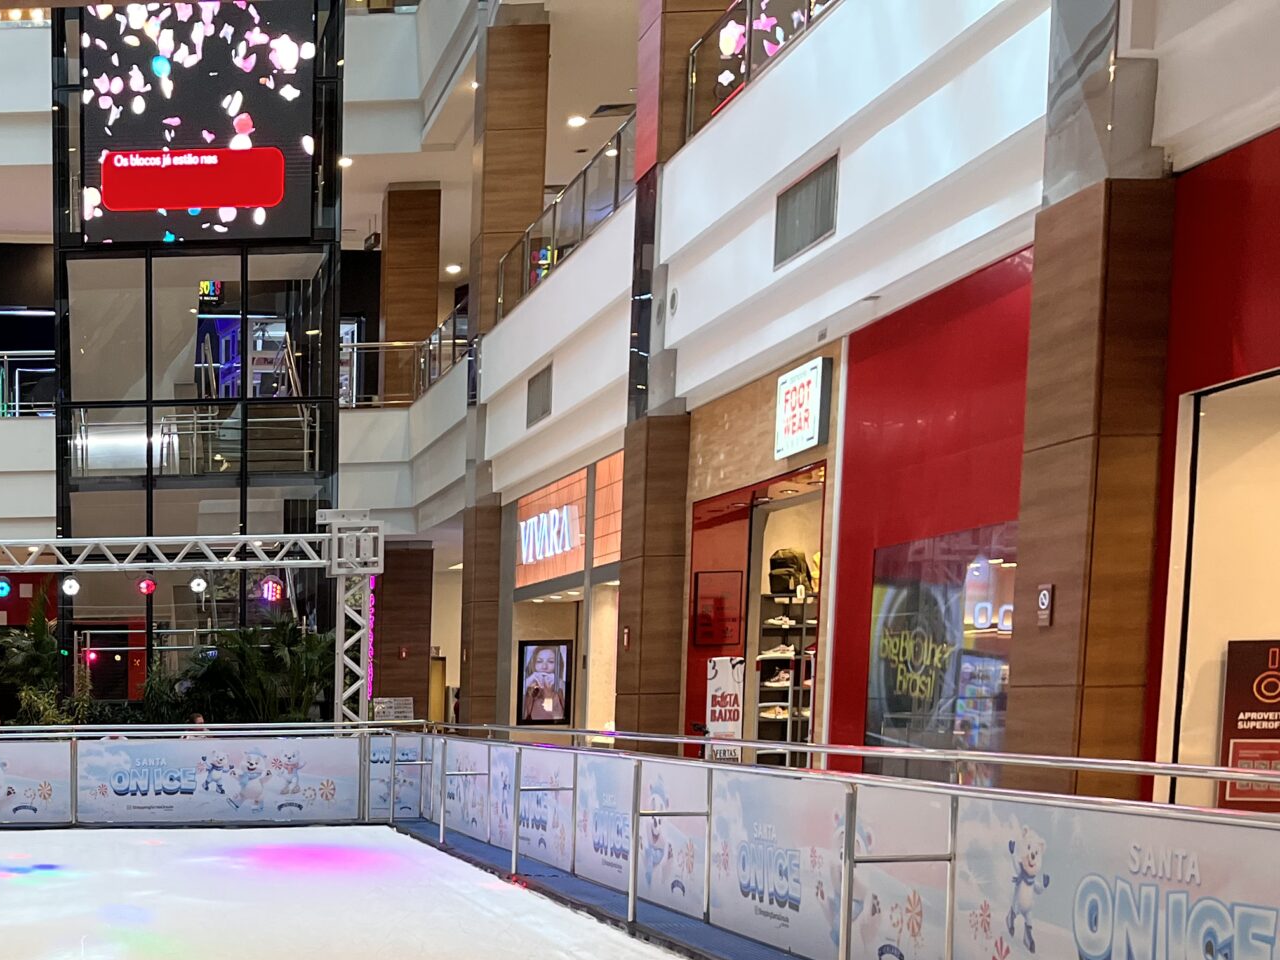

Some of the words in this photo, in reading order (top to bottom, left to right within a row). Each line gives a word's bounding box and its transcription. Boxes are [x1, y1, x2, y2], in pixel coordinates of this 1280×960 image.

[114, 154, 129, 167] Os
[130, 153, 161, 167] blocos
[161, 153, 172, 168] já
[173, 153, 199, 166] estão
[200, 154, 219, 165] nas
[784, 379, 812, 414] FOOT
[783, 408, 810, 436] WEAR
[895, 663, 936, 699] Brasil
[710, 709, 740, 722] BAIXO
[136, 757, 167, 767] SANTA
[110, 767, 150, 796] ON
[154, 767, 198, 795] ICE
[738, 840, 765, 899] ON
[766, 846, 801, 909] ICE
[1128, 845, 1201, 886] SANTA
